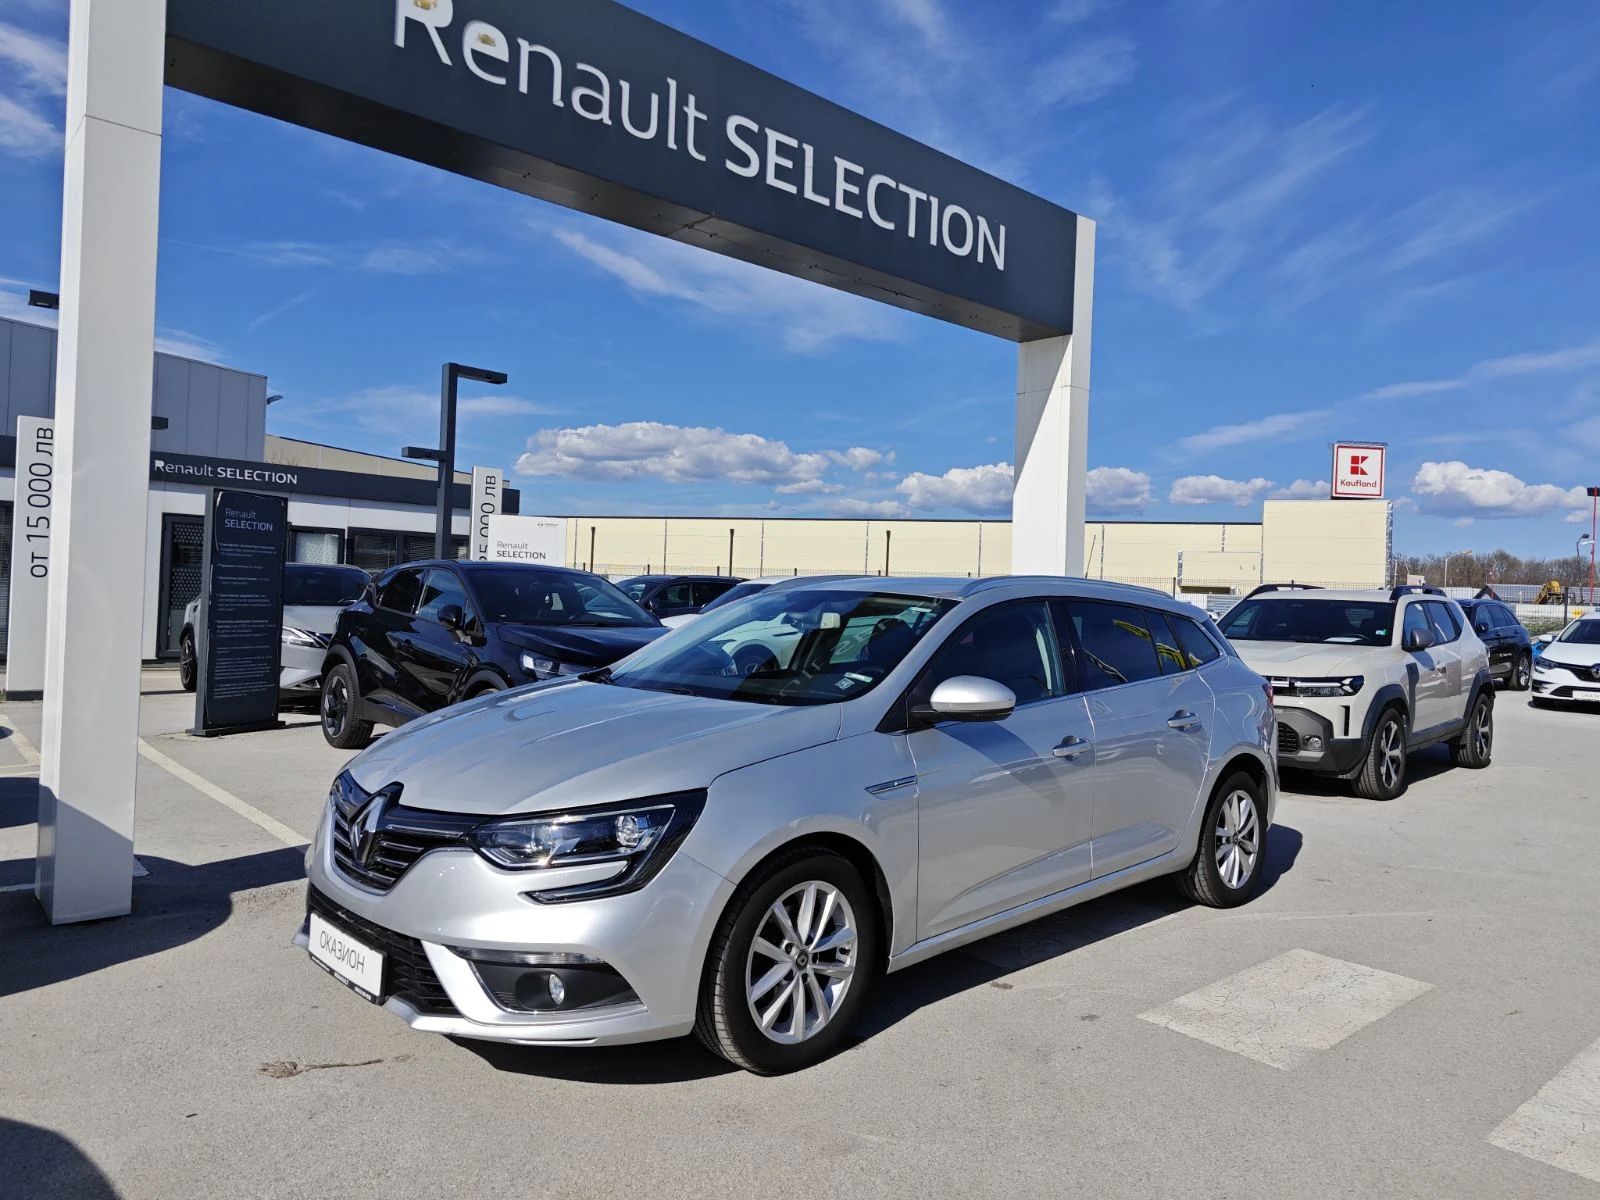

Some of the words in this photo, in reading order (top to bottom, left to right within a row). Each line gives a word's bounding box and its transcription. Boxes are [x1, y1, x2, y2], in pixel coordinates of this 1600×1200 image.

[395, 0, 708, 162] Renault
[725, 114, 1006, 271] SELECTION
[154, 460, 213, 477] Renault
[217, 466, 298, 485] SELECTION
[27, 462, 53, 508] 000
[1340, 479, 1377, 488] Kaufland
[225, 507, 257, 520] Renault
[26, 516, 50, 542] 15
[224, 519, 273, 531] SELECTION
[496, 540, 528, 550] Renault
[496, 550, 546, 560] SELECTION
[319, 930, 366, 974] ОКАЗИОН
